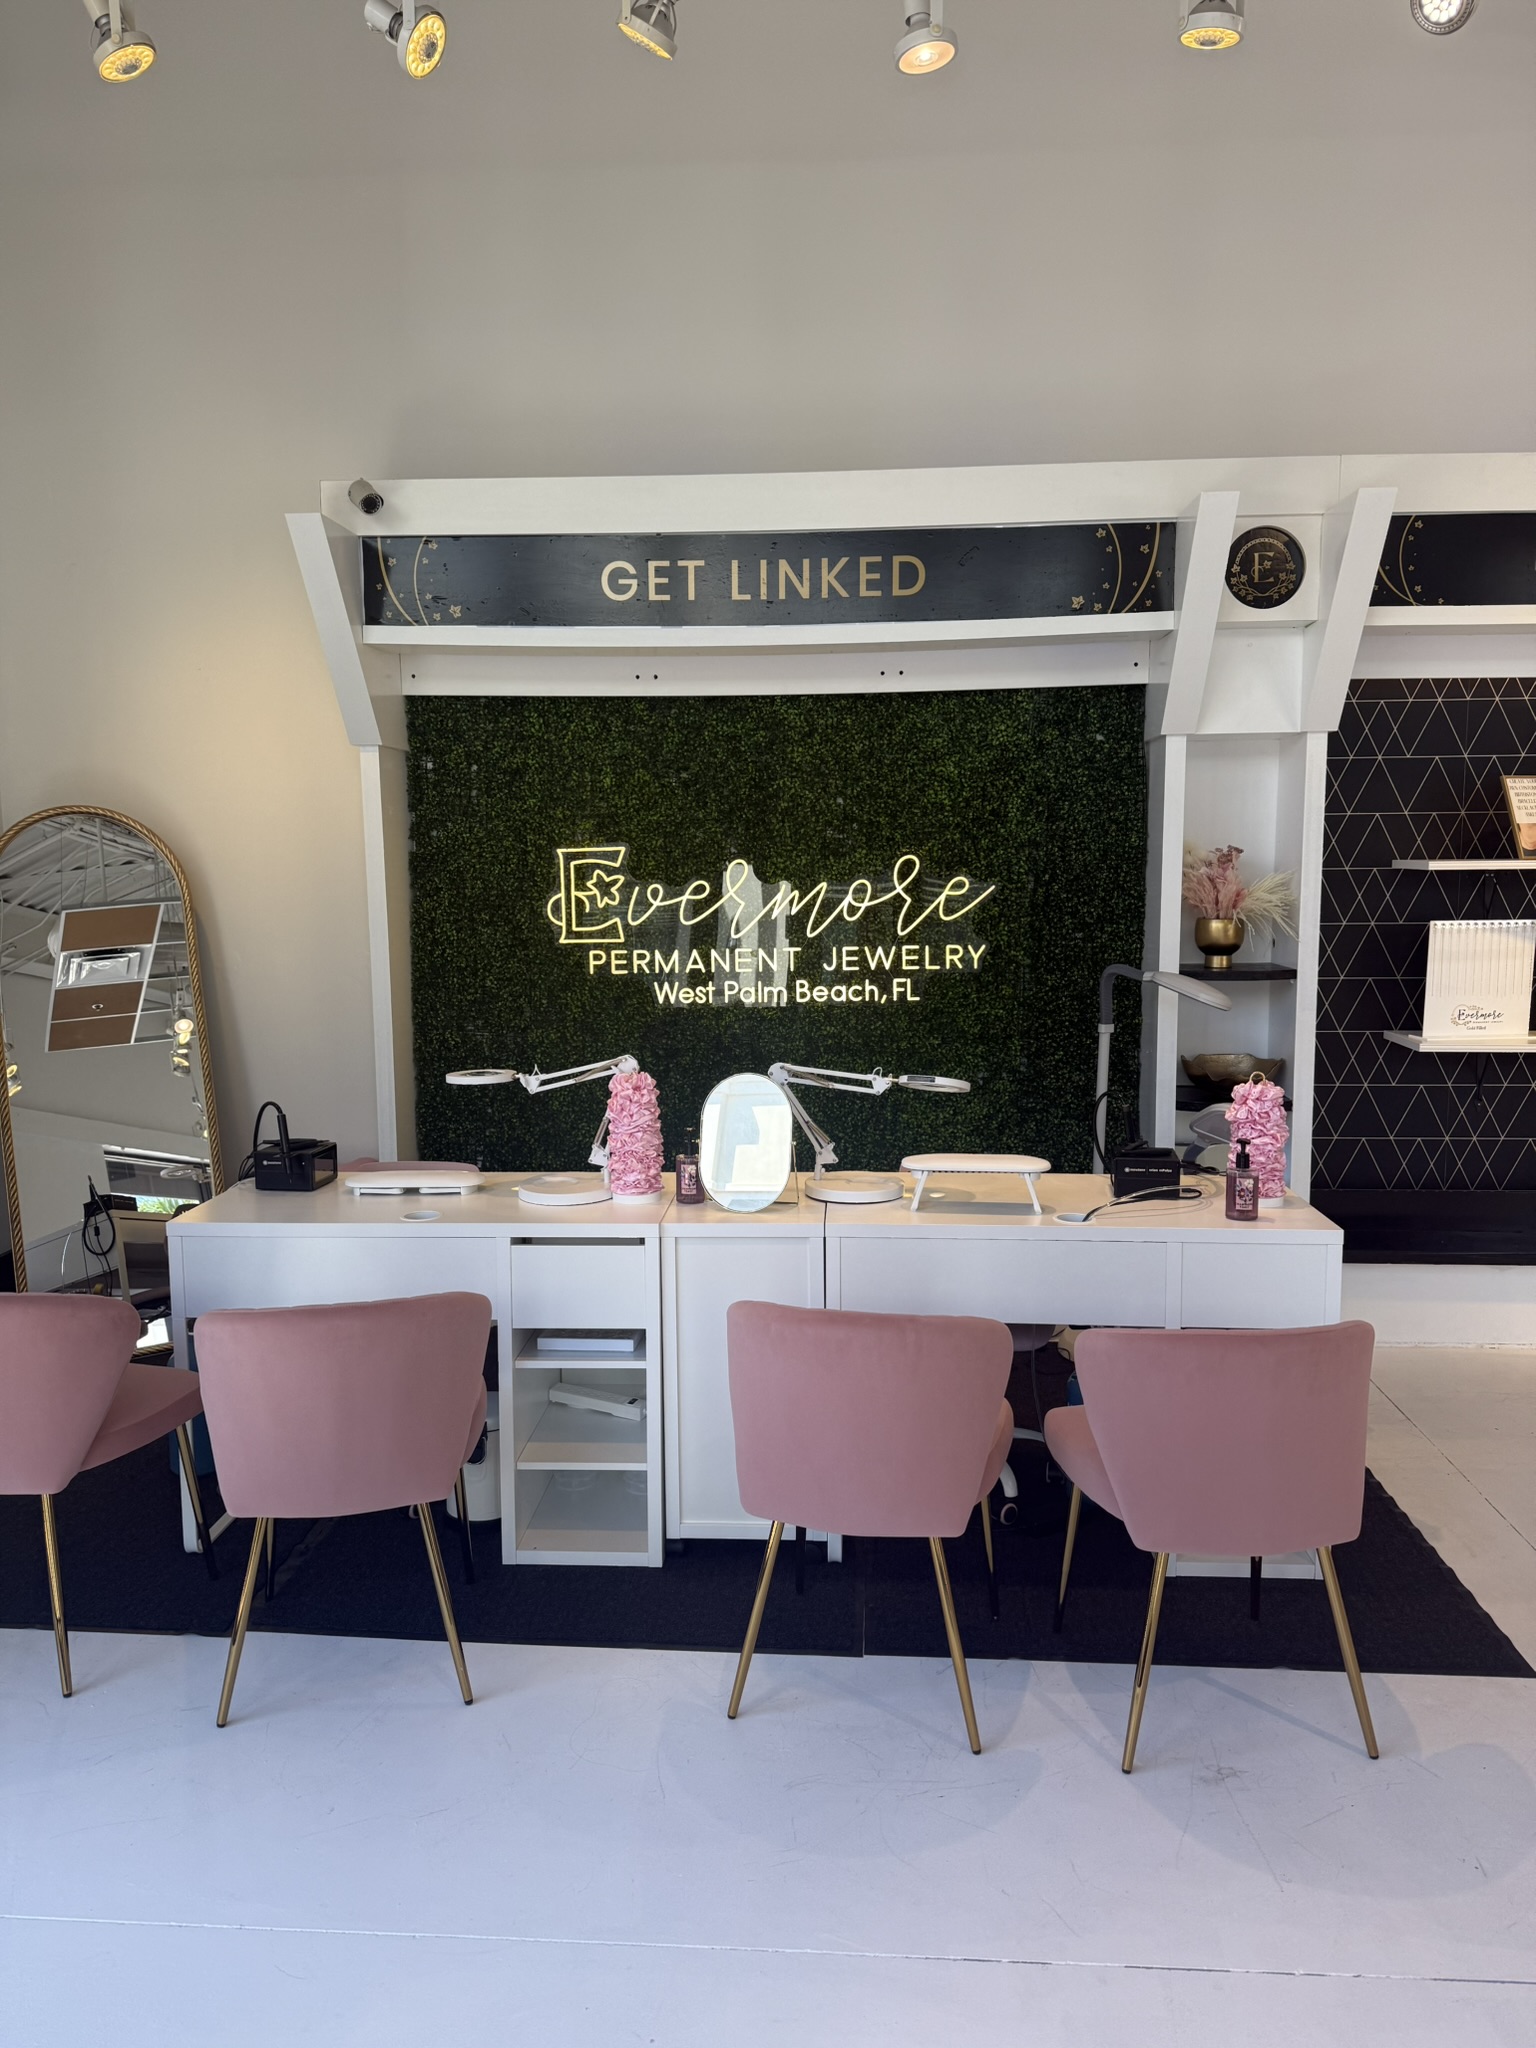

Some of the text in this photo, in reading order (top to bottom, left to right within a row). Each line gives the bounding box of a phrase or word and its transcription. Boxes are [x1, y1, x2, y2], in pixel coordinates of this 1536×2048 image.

[600, 554, 927, 601] GET LINKED
[547, 847, 996, 944] Evermore
[588, 943, 987, 976] PERMANENT JEWELRY
[653, 980, 716, 1005] West
[723, 980, 788, 1004] Palm
[1456, 1008, 1504, 1022] Evermore
